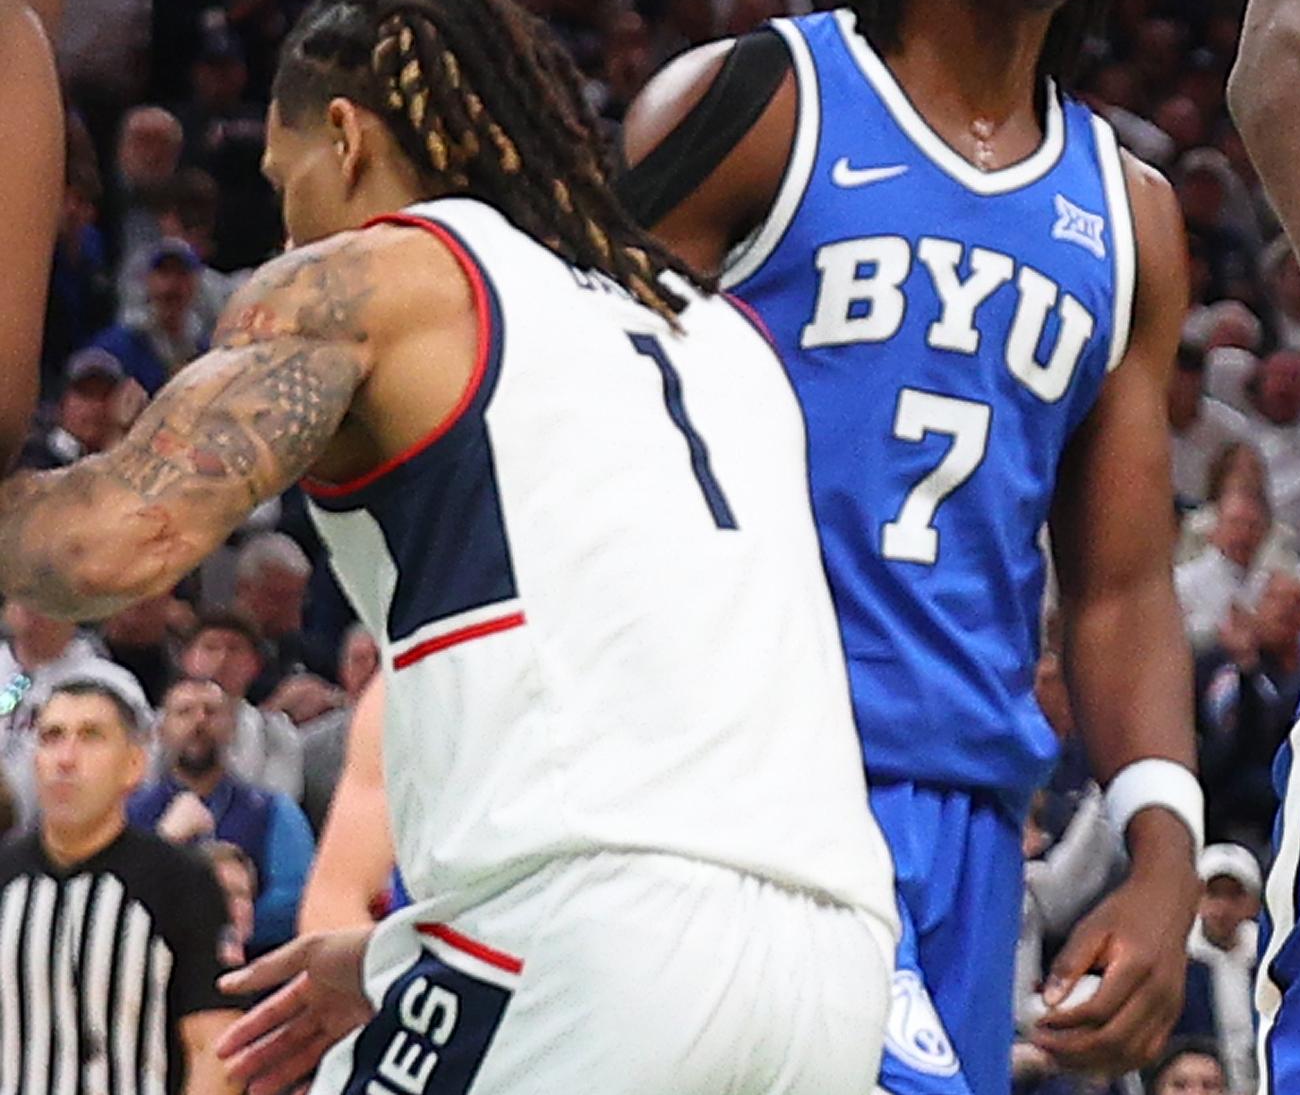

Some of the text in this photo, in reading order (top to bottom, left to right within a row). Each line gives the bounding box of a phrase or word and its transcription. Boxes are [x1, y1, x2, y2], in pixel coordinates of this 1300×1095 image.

[801, 235, 1093, 403] BYU
[626, 331, 739, 531] 1
[880, 385, 992, 565] 7
